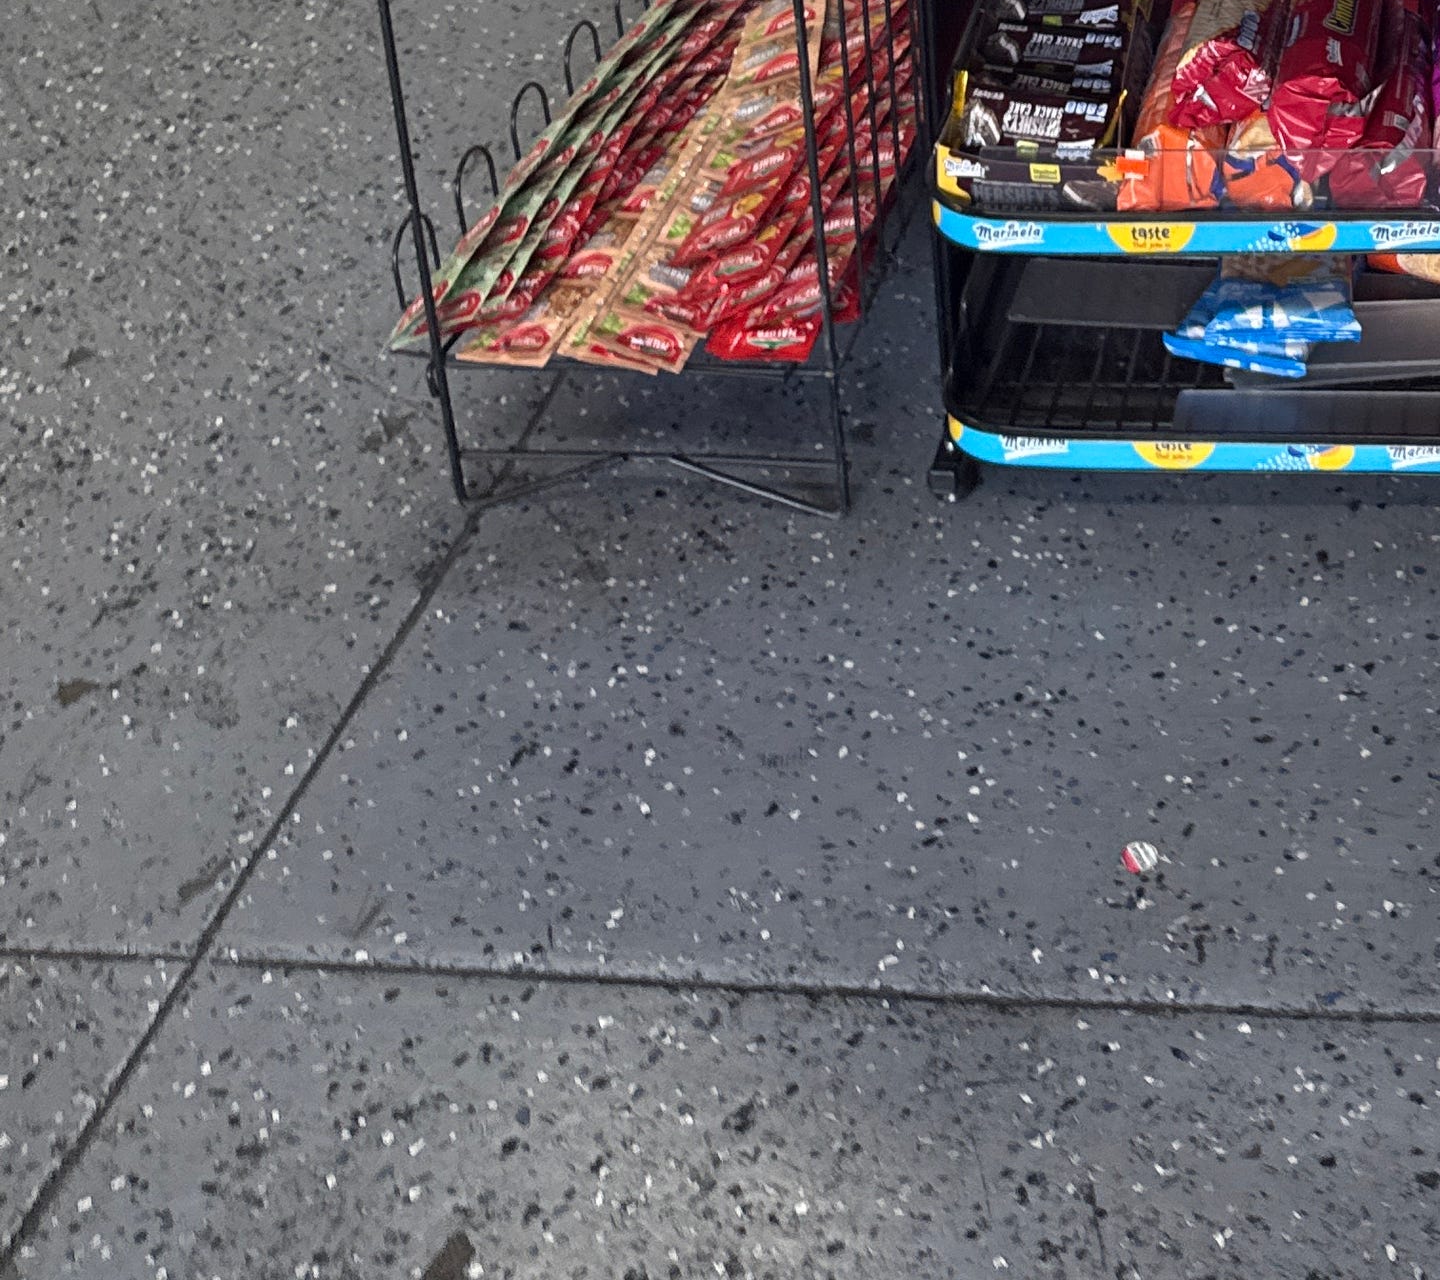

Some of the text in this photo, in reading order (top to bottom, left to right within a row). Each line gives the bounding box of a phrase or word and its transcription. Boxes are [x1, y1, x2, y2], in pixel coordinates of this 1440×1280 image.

[1007, 101, 1064, 119] SNACK CAKE
[1001, 112, 1062, 139] HERSHEY'S
[975, 222, 1042, 240] Marinela
[1131, 226, 1170, 240] taste
[1375, 222, 1440, 242] Marinela
